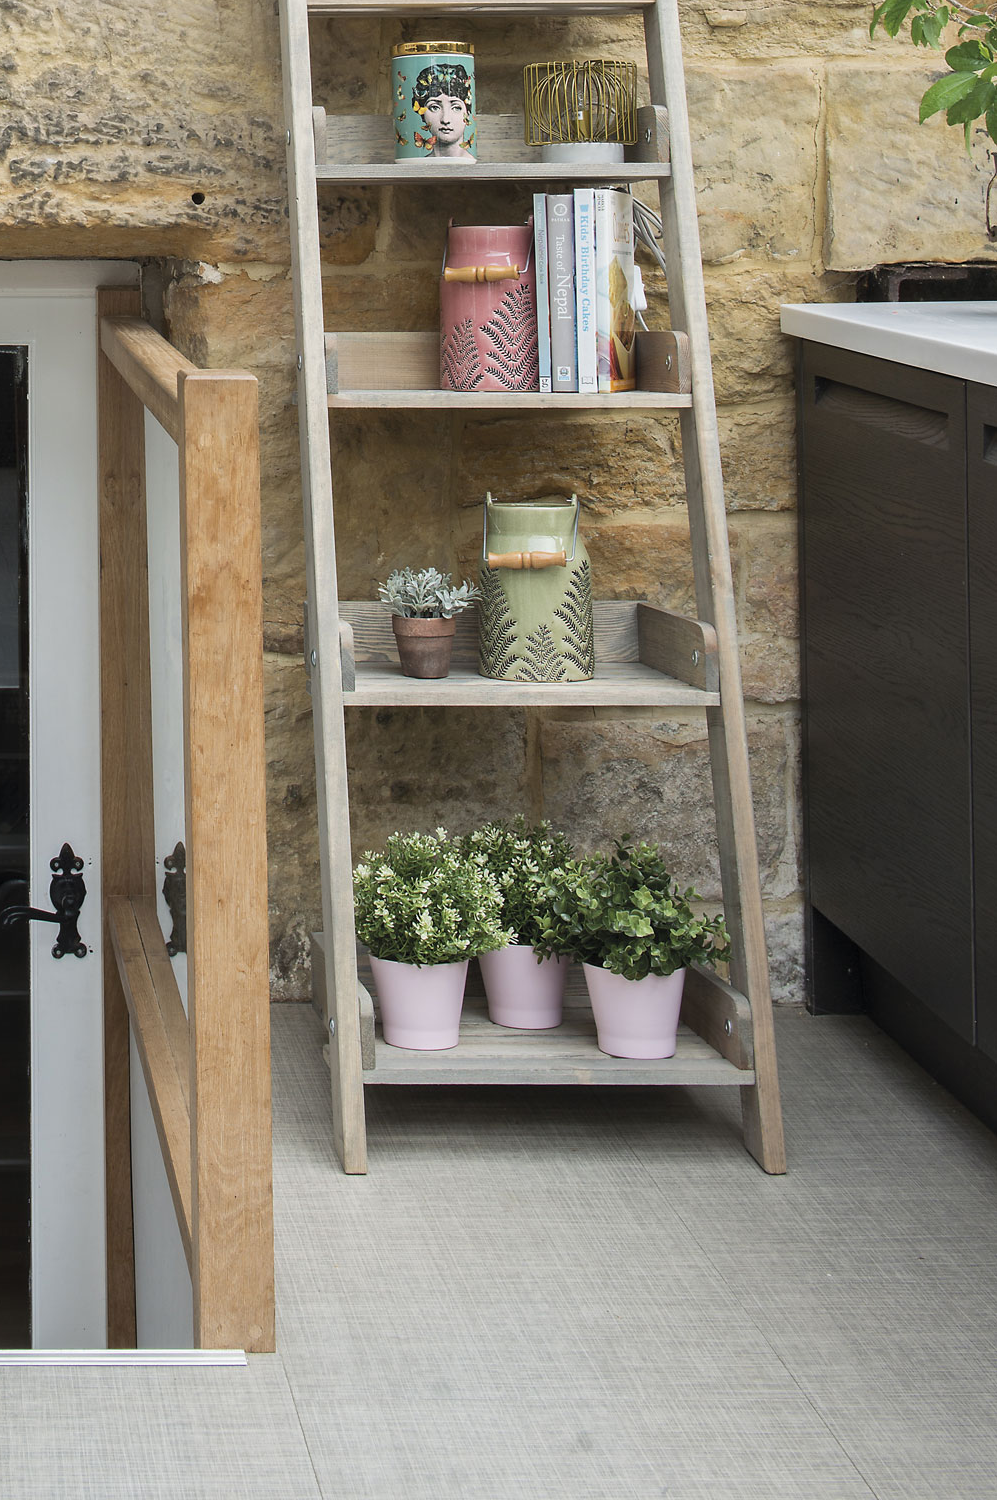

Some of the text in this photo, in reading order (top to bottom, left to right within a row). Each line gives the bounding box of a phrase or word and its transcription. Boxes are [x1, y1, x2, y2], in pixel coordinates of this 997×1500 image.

[554, 234, 572, 320] Taste of Nepal
[578, 215, 590, 332] Kids' Birthday Cakes
